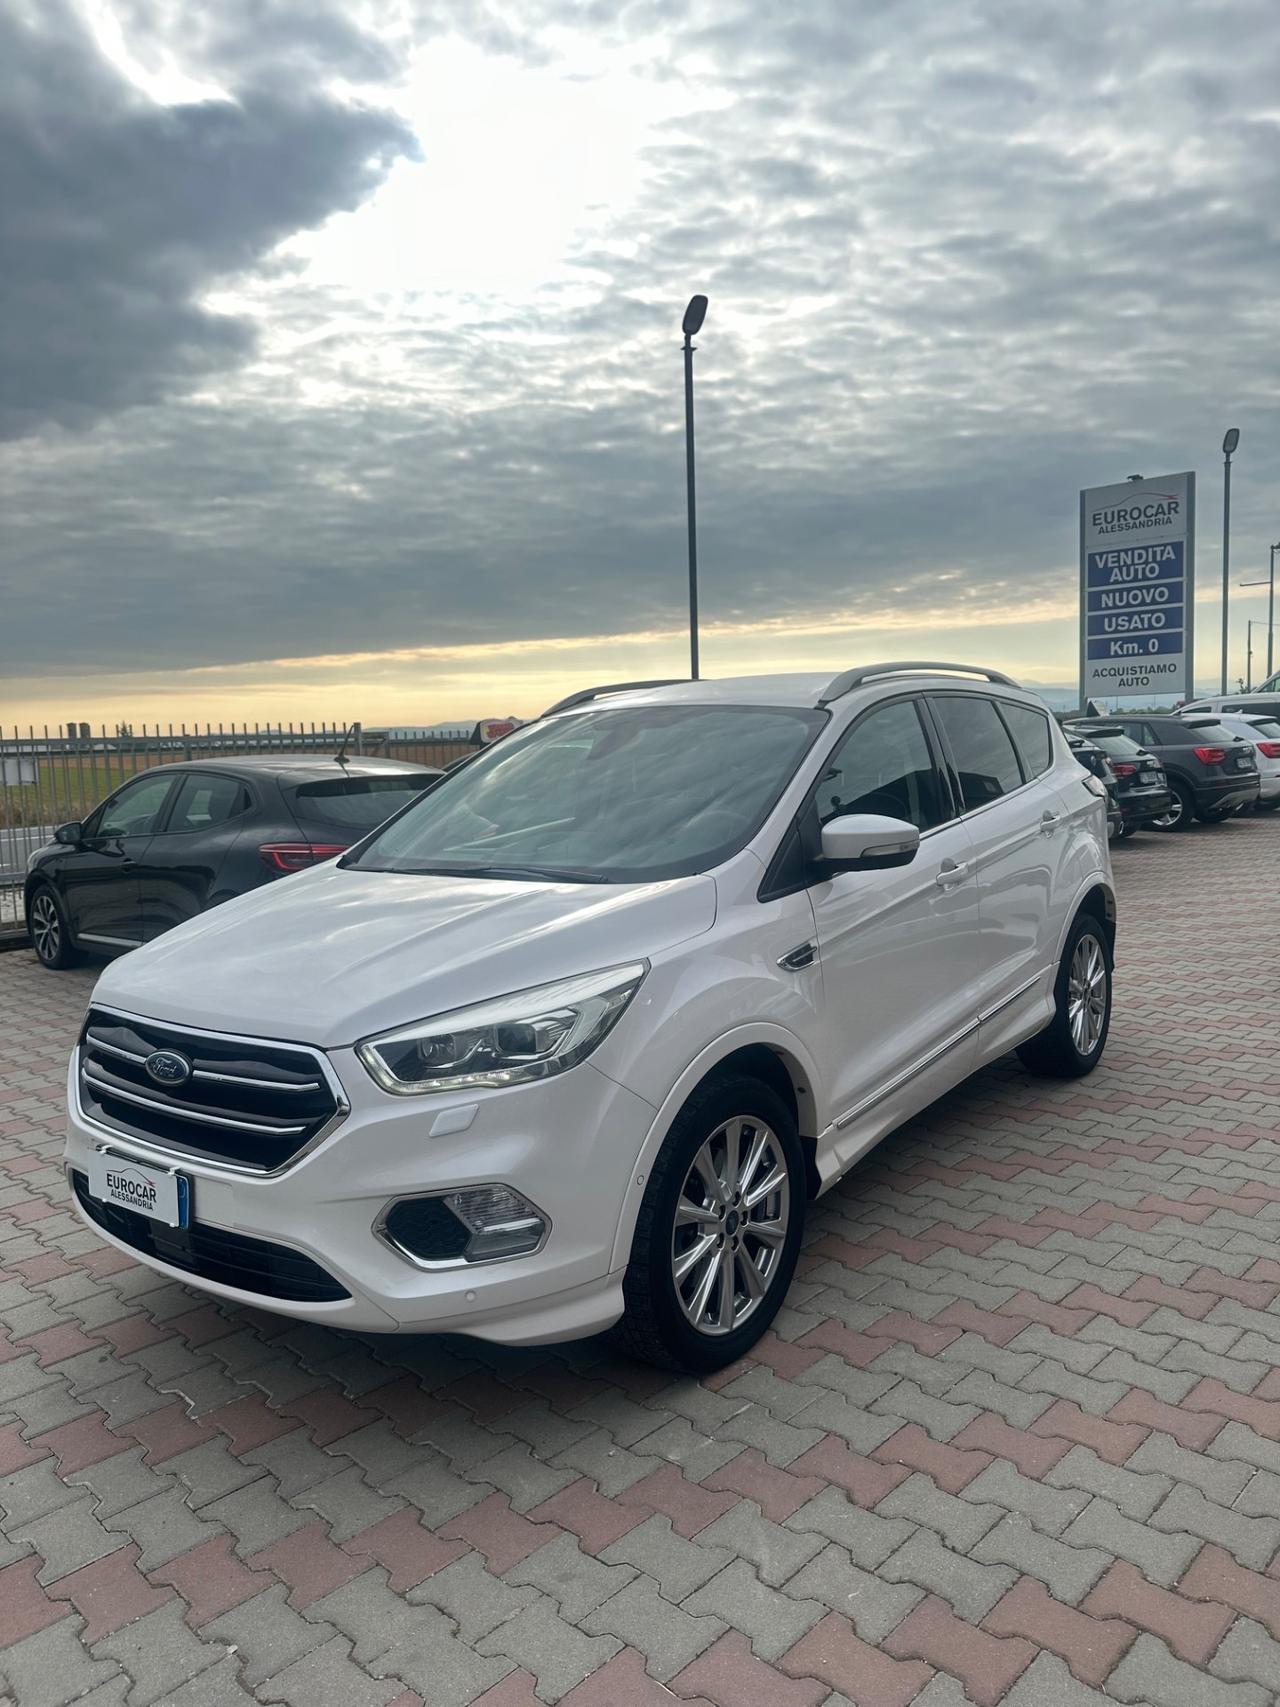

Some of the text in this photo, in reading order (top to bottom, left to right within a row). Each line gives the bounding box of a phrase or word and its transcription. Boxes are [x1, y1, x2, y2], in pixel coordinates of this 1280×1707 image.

[1092, 500, 1180, 527] EUROCAR
[1098, 516, 1173, 535] ALESSANDRIA
[1095, 545, 1176, 569] VENDITA
[1109, 563, 1160, 583] AUTO
[1101, 586, 1169, 609] NUOVO
[1104, 612, 1166, 633] USATO
[1110, 638, 1159, 656] Km. 0
[1092, 662, 1177, 679] ACQUISTIAMO
[1118, 676, 1150, 688] AUTO
[106, 1173, 157, 1203] EUROCAR
[110, 1188, 154, 1211] ALESSANDRIA
